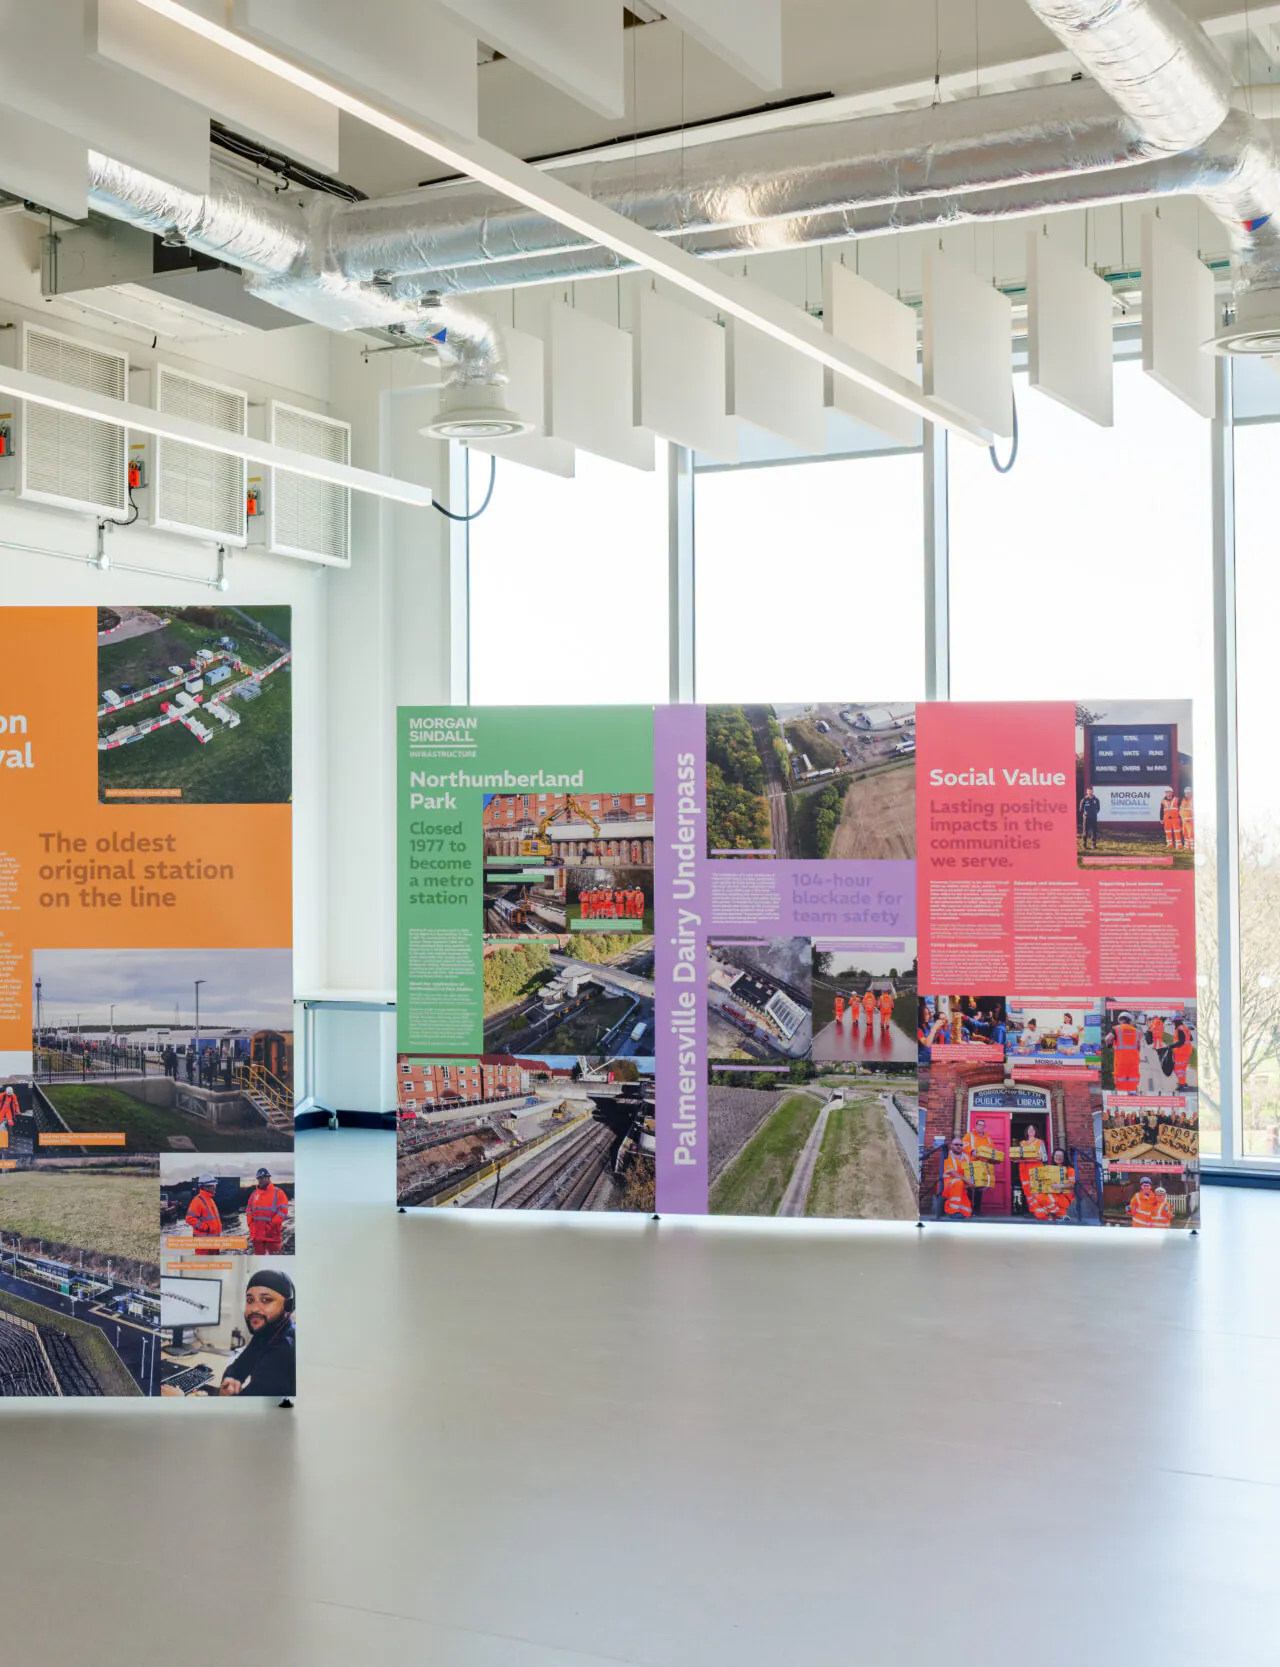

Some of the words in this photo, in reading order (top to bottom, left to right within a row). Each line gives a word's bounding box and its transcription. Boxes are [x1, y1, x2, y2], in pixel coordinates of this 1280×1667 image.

[410, 718, 477, 729] MORGAN
[410, 731, 474, 742] SINDALL
[410, 770, 583, 788] Northumberland
[930, 768, 995, 786] Social
[1000, 769, 1066, 786] Value
[410, 792, 456, 810] Park
[930, 798, 995, 814] Lasting
[1000, 798, 1068, 816] positive
[410, 821, 462, 836] Closed
[670, 752, 701, 900] Underpass
[930, 817, 997, 834] impacts
[1004, 818, 1018, 831] in
[1024, 817, 1053, 831] the
[38, 832, 87, 853] The
[96, 831, 176, 853] oldest
[410, 840, 444, 852] 1977
[450, 840, 466, 852] to
[930, 835, 1040, 849] communities
[410, 857, 471, 871] become
[932, 857, 956, 867] we
[962, 857, 1013, 867] serve.
[38, 858, 136, 886] original
[144, 858, 234, 880] station
[792, 873, 873, 887] 104-hour
[410, 878, 419, 888] a
[424, 876, 474, 887] metro
[38, 892, 70, 908] on
[79, 886, 122, 908] the
[130, 886, 176, 908] line
[410, 891, 468, 905] station
[793, 891, 871, 905] blockade
[877, 891, 904, 905] for
[793, 910, 837, 922] team
[844, 909, 899, 925] safety
[670, 908, 702, 983] Dairy
[671, 992, 697, 1165] Palmersville
